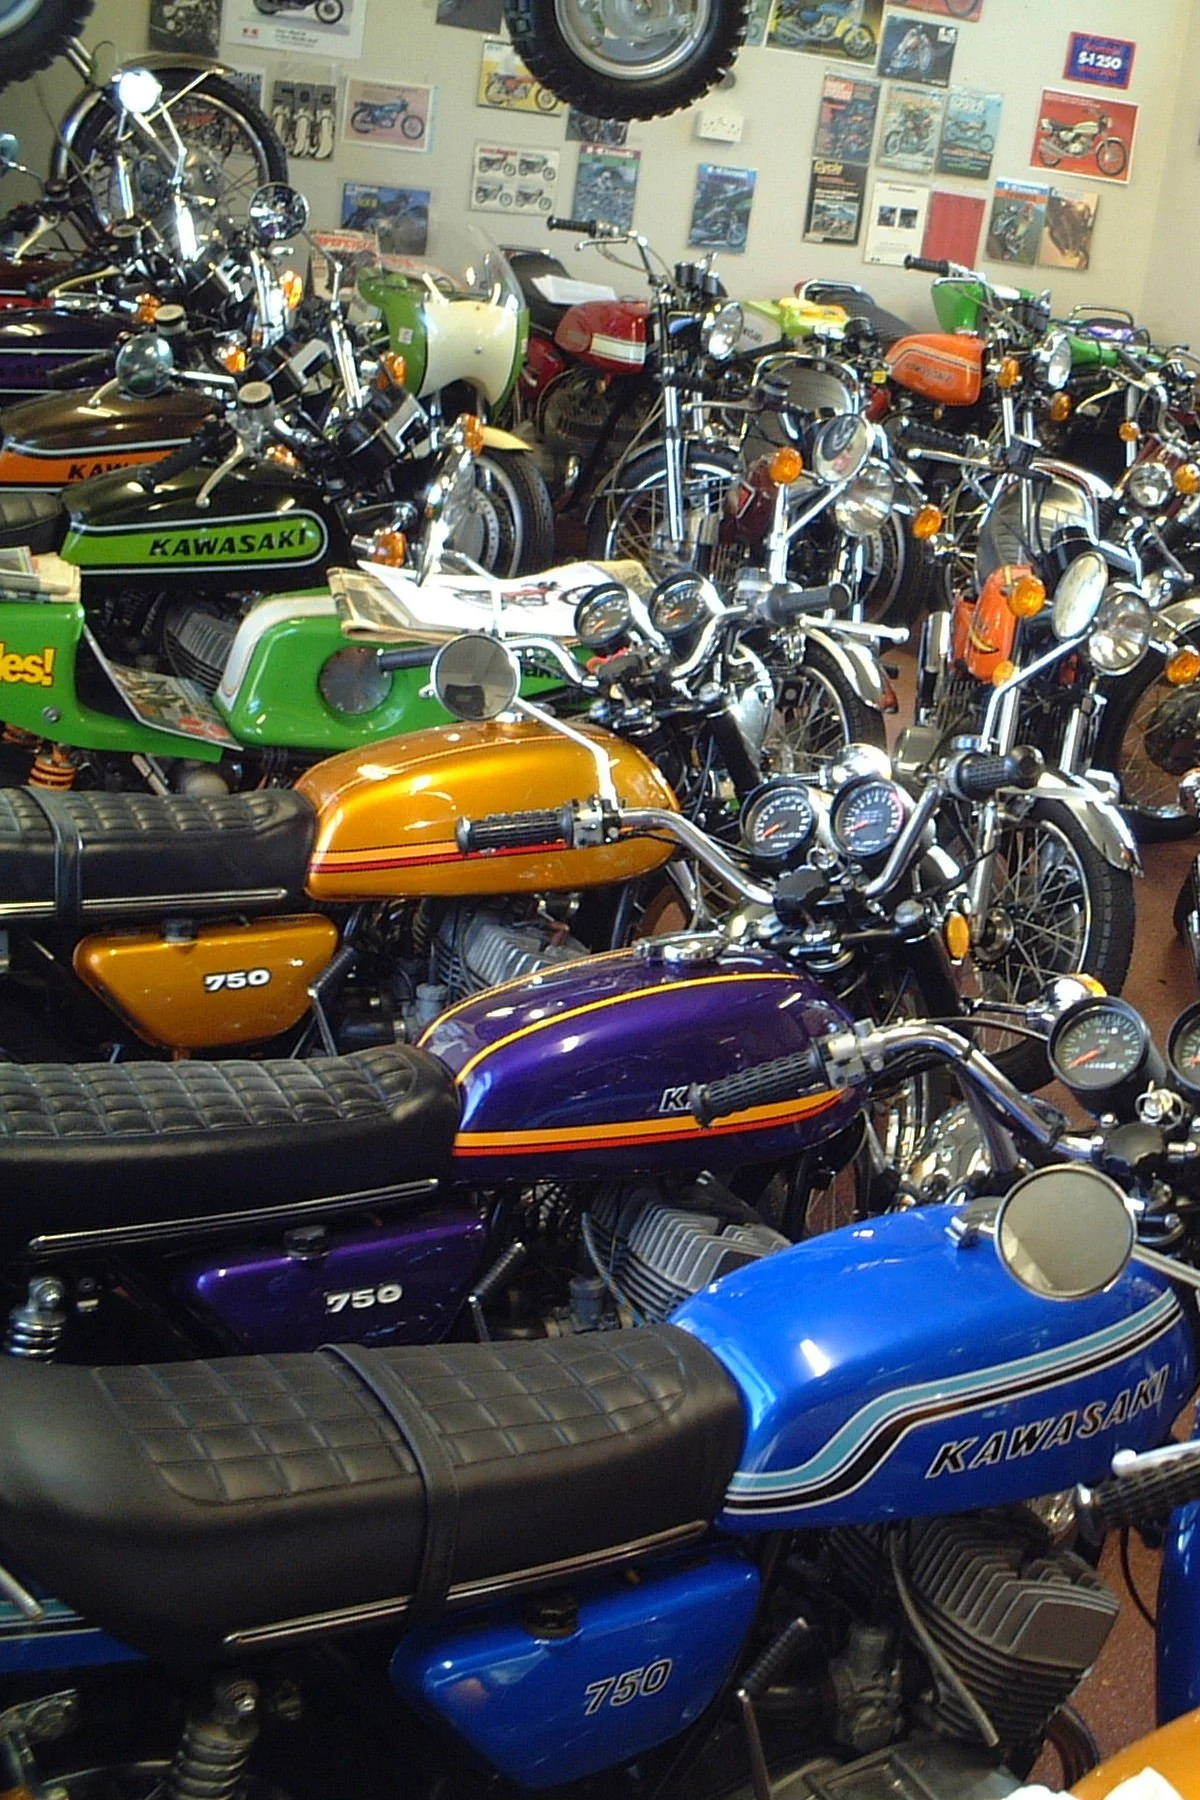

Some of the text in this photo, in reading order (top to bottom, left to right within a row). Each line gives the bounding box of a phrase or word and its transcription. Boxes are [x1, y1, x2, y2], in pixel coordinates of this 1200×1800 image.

[1093, 53, 1123, 70] 250
[149, 527, 307, 557] KAWASAKI
[203, 966, 272, 993] 750
[324, 1282, 404, 1314] 750
[925, 1363, 1172, 1480] KAWASAKI
[583, 1657, 674, 1717] 750
